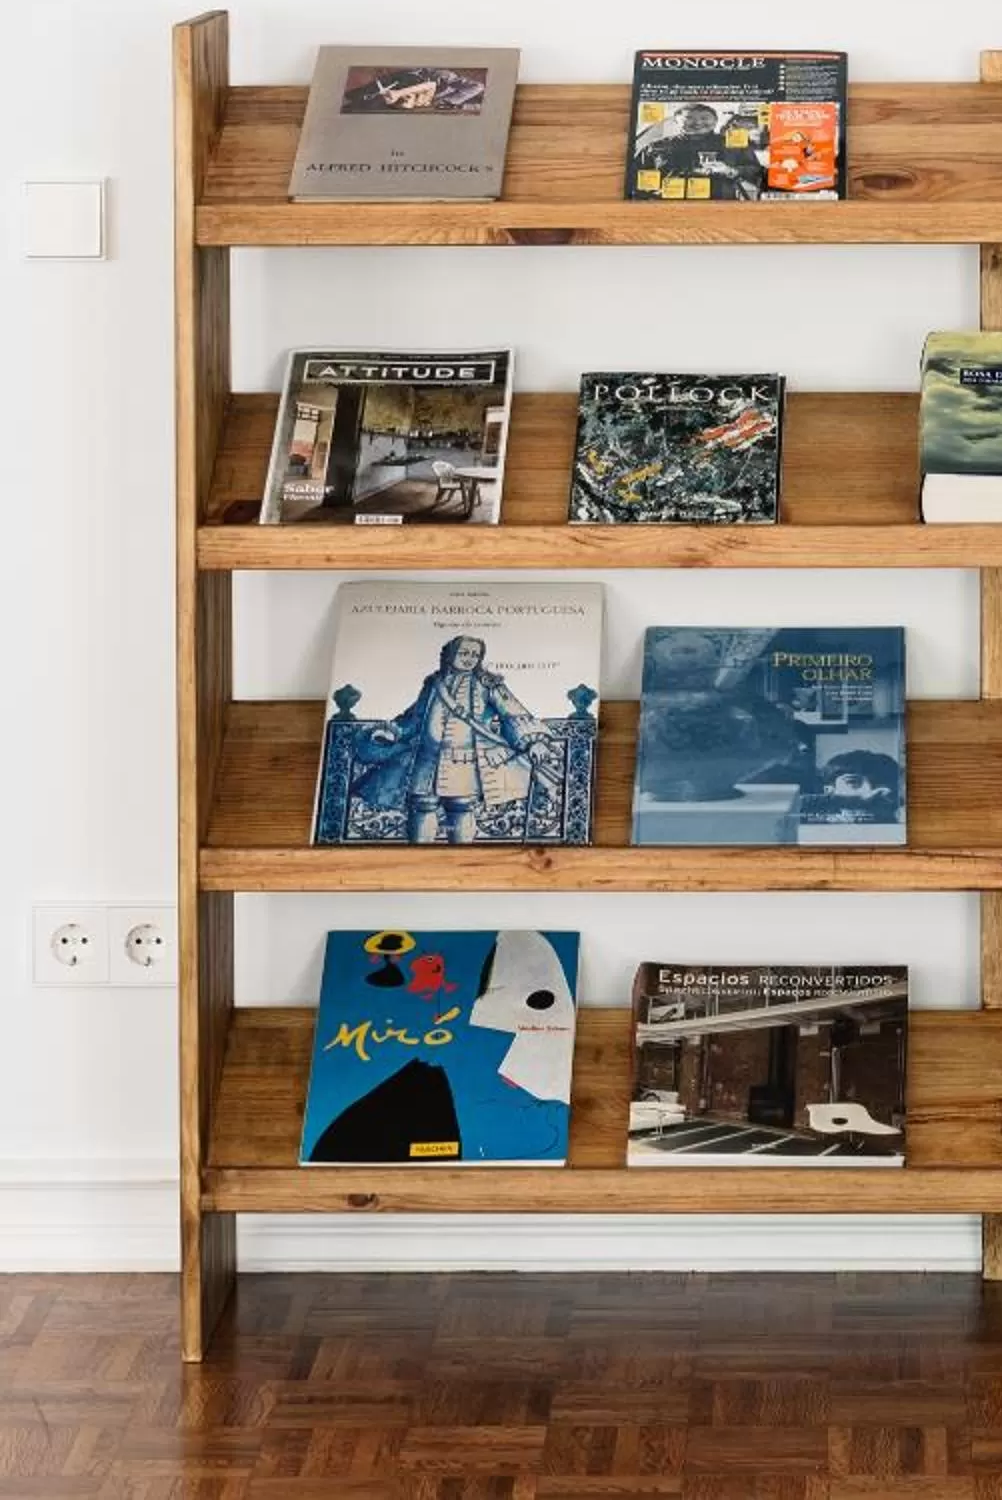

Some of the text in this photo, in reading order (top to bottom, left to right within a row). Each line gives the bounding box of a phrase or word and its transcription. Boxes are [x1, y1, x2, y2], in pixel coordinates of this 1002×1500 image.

[642, 57, 766, 68] MONOCLE
[306, 163, 371, 173] ALFRED
[318, 365, 477, 379] ATTITUDE
[593, 385, 770, 401] POLLOCK
[431, 605, 494, 615] BARROCA
[498, 604, 585, 615] PORTUGUESA
[801, 668, 874, 682] OLHAR
[659, 969, 893, 990] Espacios RECONVERTIDOS
[323, 1006, 461, 1061] Miró
